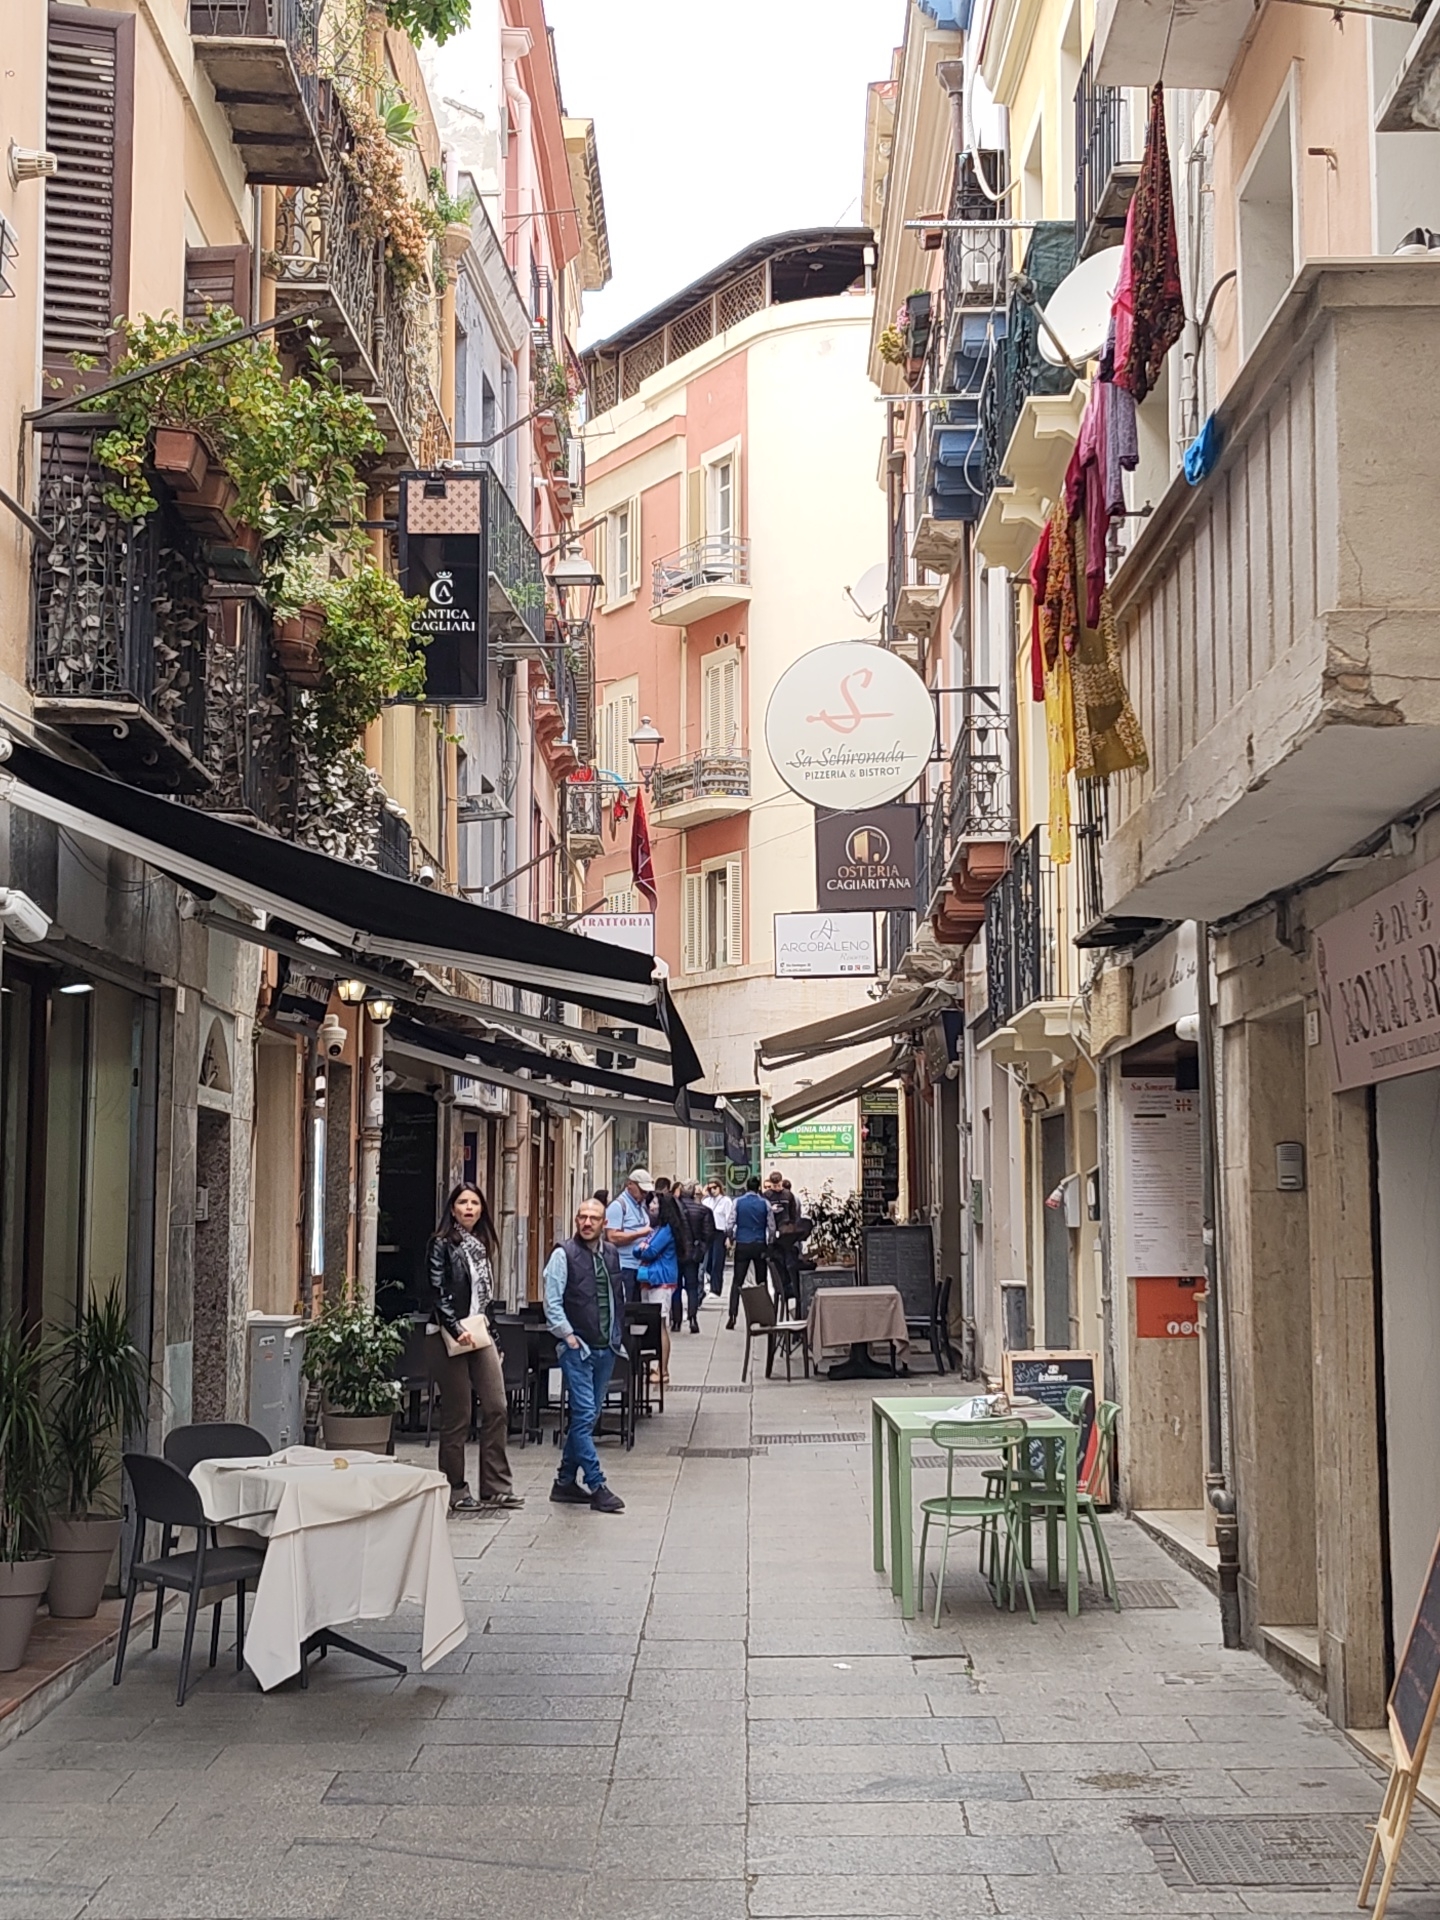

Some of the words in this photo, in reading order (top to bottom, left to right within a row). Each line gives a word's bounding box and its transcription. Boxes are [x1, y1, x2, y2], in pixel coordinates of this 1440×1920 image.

[418, 608, 470, 620] ANTICA
[410, 620, 476, 632] CAGLIARI
[816, 740, 907, 768] Schironada
[804, 769, 847, 781] PIZZERIA
[849, 769, 857, 779] &
[859, 766, 901, 778] BISTROT
[837, 864, 901, 879] OSTERIA
[581, 917, 651, 928] TRATTORIA
[779, 939, 871, 954] ARCOBALENO
